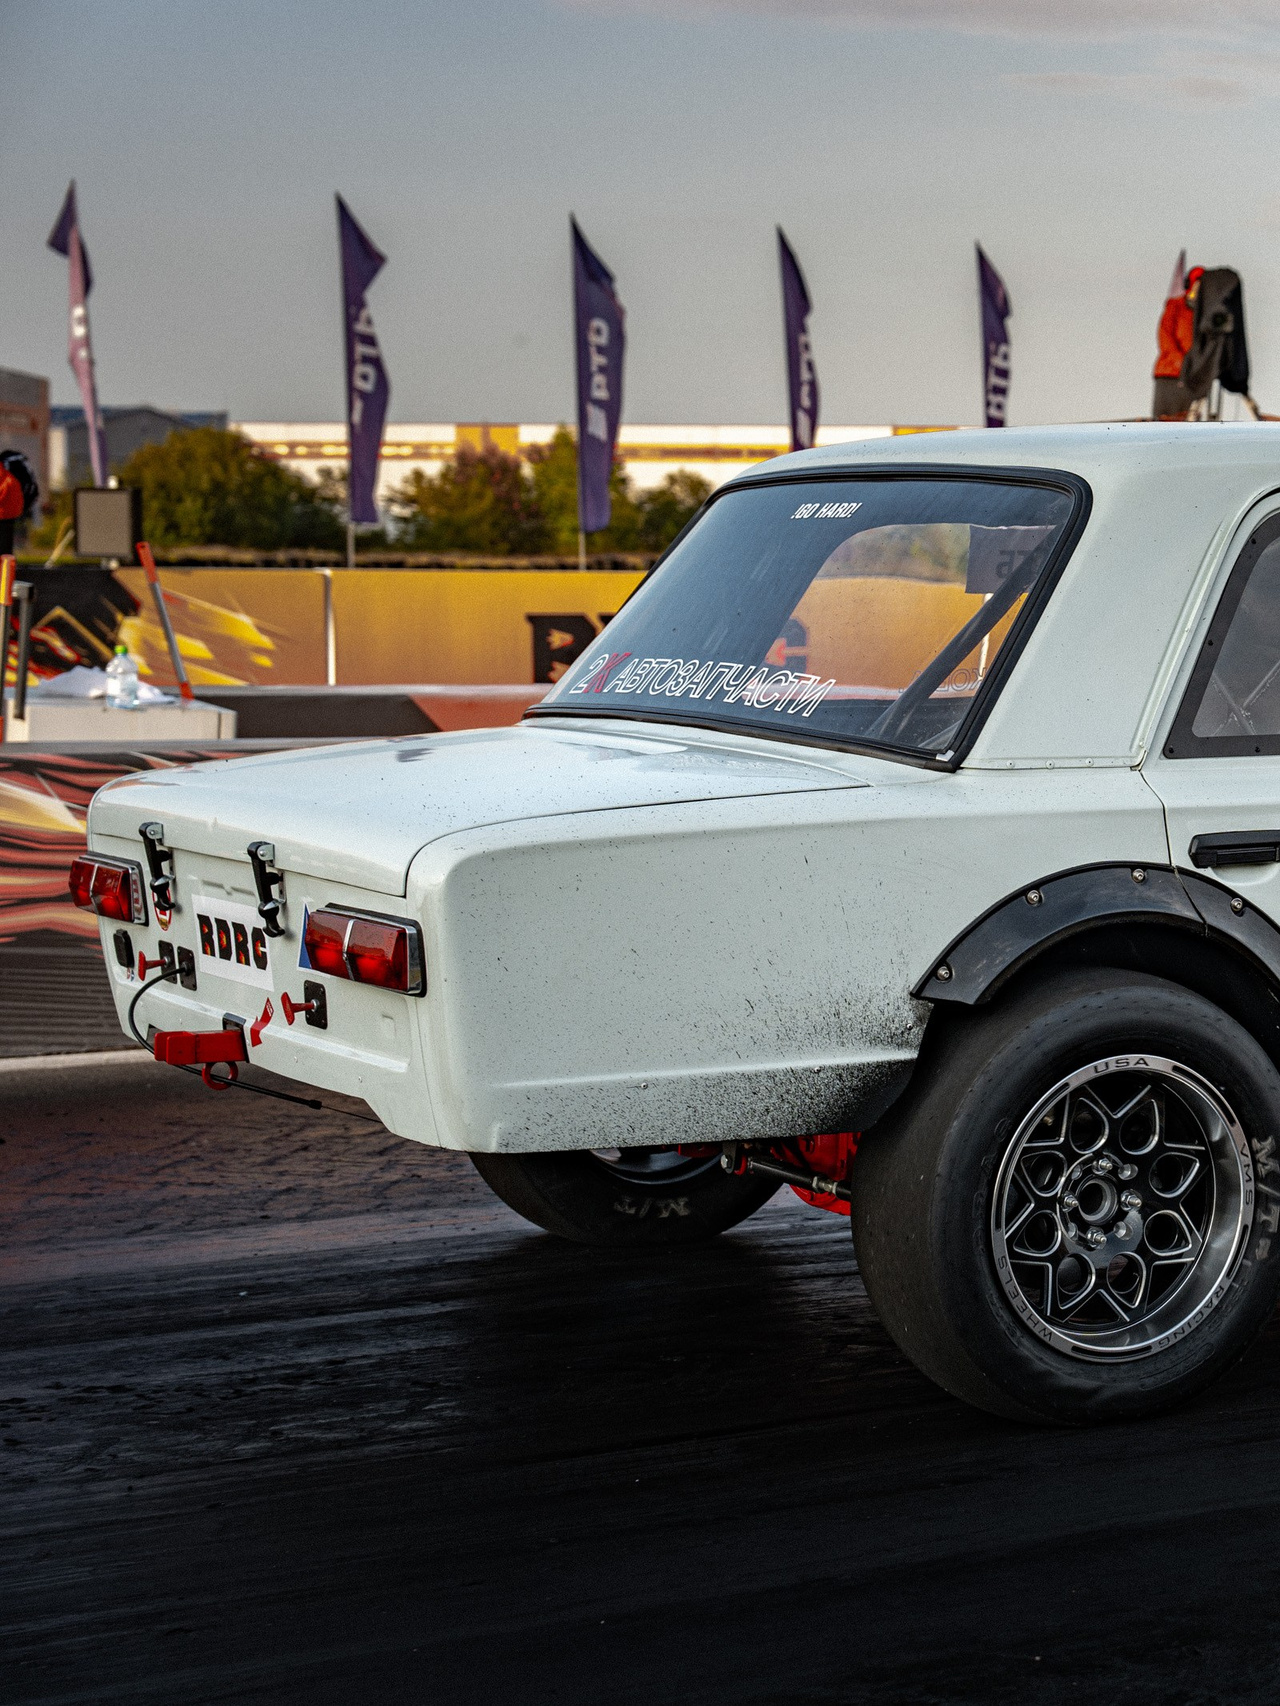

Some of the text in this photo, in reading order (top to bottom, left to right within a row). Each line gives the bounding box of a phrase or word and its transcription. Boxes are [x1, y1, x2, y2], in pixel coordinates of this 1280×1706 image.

[814, 502, 862, 518] HARD!
[197, 913, 269, 971] RDRC
[1094, 1057, 1150, 1074] USA
[1240, 1142, 1254, 1205] VMS
[997, 1253, 1054, 1342] WHEELS
[1157, 1285, 1225, 1348] RACING
